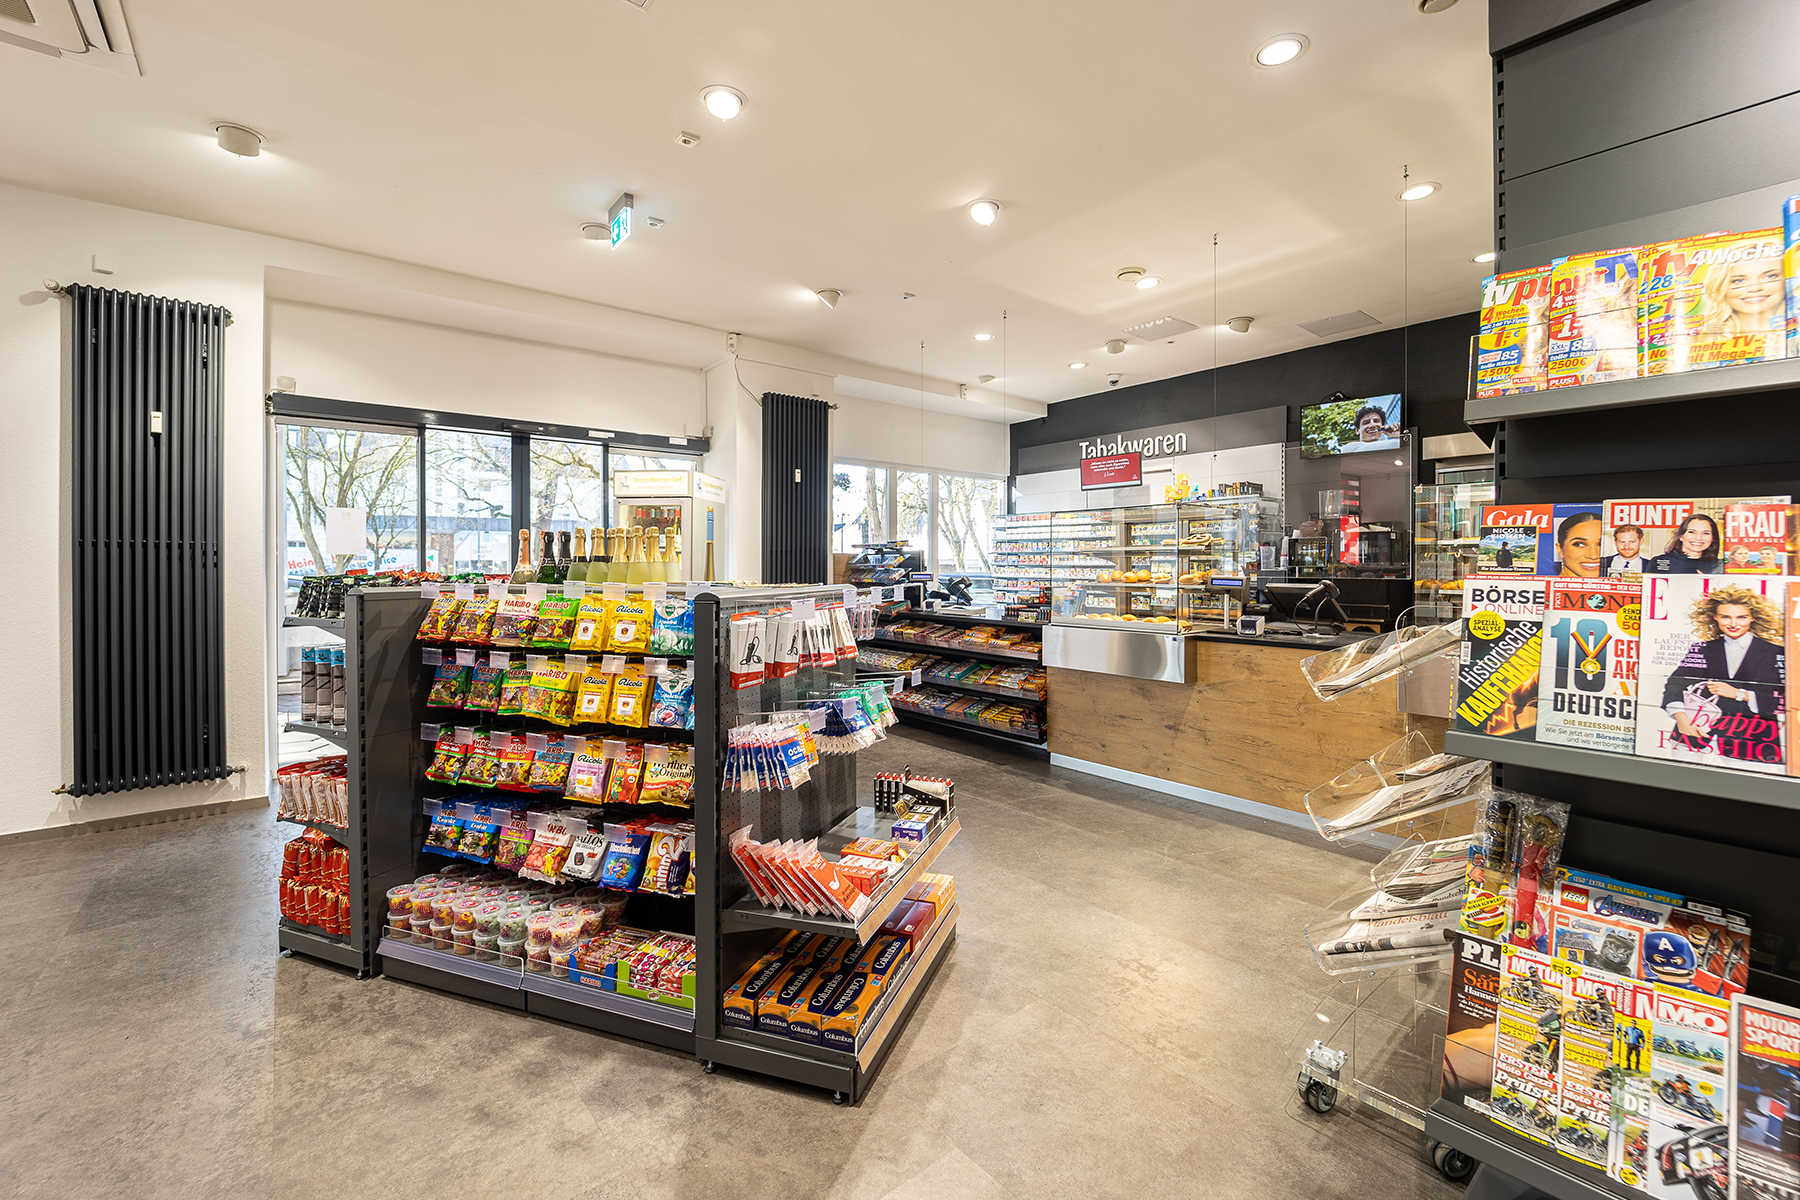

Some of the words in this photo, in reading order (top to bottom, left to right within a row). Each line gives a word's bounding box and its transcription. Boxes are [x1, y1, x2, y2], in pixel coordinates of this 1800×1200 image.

[1553, 269, 1609, 298] nur
[1594, 252, 1639, 285] TV
[1482, 307, 1495, 324] 4
[1501, 349, 1519, 360] 85
[1481, 365, 1511, 378] 2500
[1549, 358, 1579, 371] 2500
[1549, 377, 1576, 386] PLUS!
[1486, 509, 1549, 528] Gala
[1613, 504, 1690, 526] BUNTE
[1726, 511, 1786, 538] FRAU
[1471, 585, 1546, 605] BÖRSE
[504, 599, 532, 609] HARIBO
[543, 601, 570, 610] HARIBO
[580, 604, 605, 614] Ricola
[615, 604, 645, 615] Ricola
[1484, 603, 1545, 616] ONLINE
[1472, 625, 1502, 633] ANALYSE
[1670, 632, 1691, 640] DER
[1457, 620, 1539, 690] Historische
[583, 676, 608, 686] Ricola
[617, 678, 643, 688] Ricola
[1563, 719, 1576, 727] DIE
[1577, 720, 1622, 732] REZESSION
[1690, 705, 1780, 742] happy
[577, 754, 604, 765] Ricola
[660, 766, 692, 780] Original
[1562, 890, 1587, 904] LEGO
[1593, 894, 1663, 925] AVENGERS
[874, 941, 901, 969] Columbus
[746, 961, 781, 993] Columbus
[1564, 966, 1572, 976] 3
[580, 975, 601, 987] HARIBO
[781, 966, 814, 998] Columbus
[811, 973, 844, 1007] Columbus
[833, 977, 865, 1011] Columbus
[725, 1009, 751, 1021] Columbus
[760, 1016, 788, 1028] Columbus
[1658, 1001, 1729, 1034] MO
[790, 1023, 819, 1037] Columbus
[1744, 1009, 1800, 1038] MOTOR
[824, 1031, 853, 1044] Columbus
[1499, 1023, 1536, 1045] SPECIAL
[1744, 1025, 1800, 1055] SPORT
[1498, 1052, 1550, 1078] ERSTER
[1564, 1049, 1607, 1071] SPECIAL
